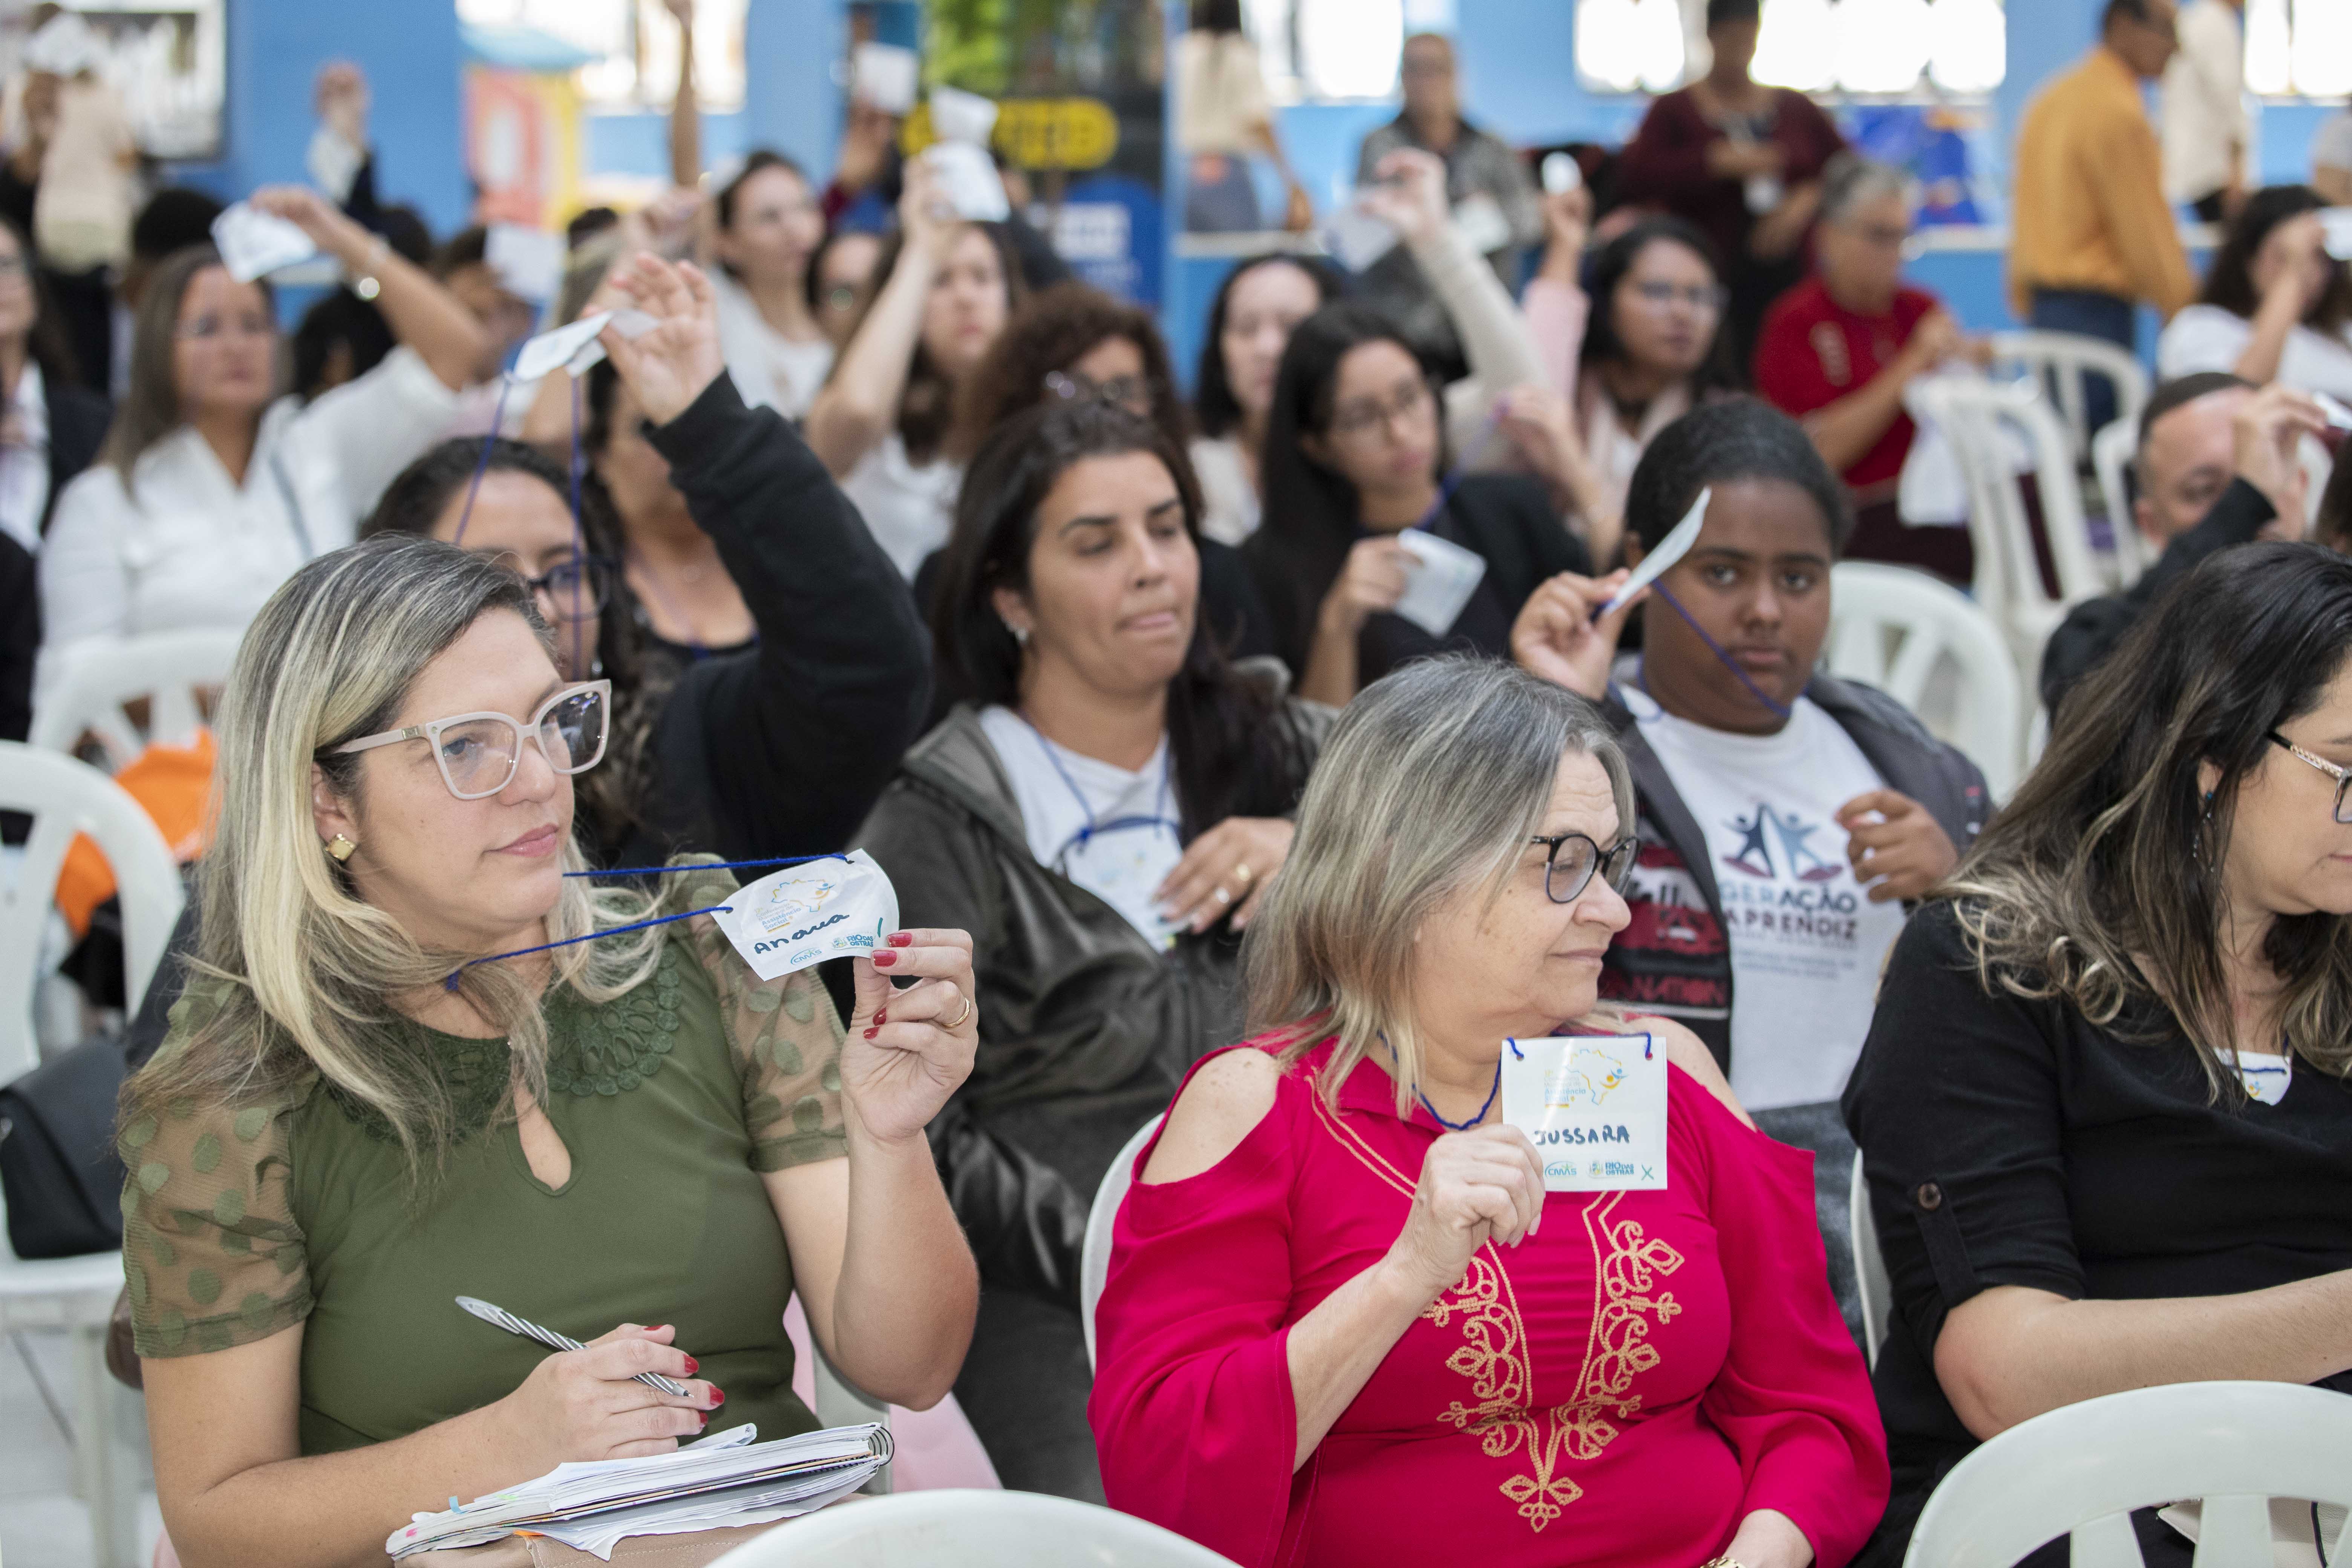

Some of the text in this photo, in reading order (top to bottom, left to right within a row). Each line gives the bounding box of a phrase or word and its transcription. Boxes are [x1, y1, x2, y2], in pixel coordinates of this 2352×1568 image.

[1720, 881, 1857, 915] GERAÇÃO
[764, 917, 788, 930] Social
[1723, 907, 1857, 940] APRENDIZ
[793, 949, 822, 963] CMAS
[1534, 1124, 1630, 1145] JUSSARA
